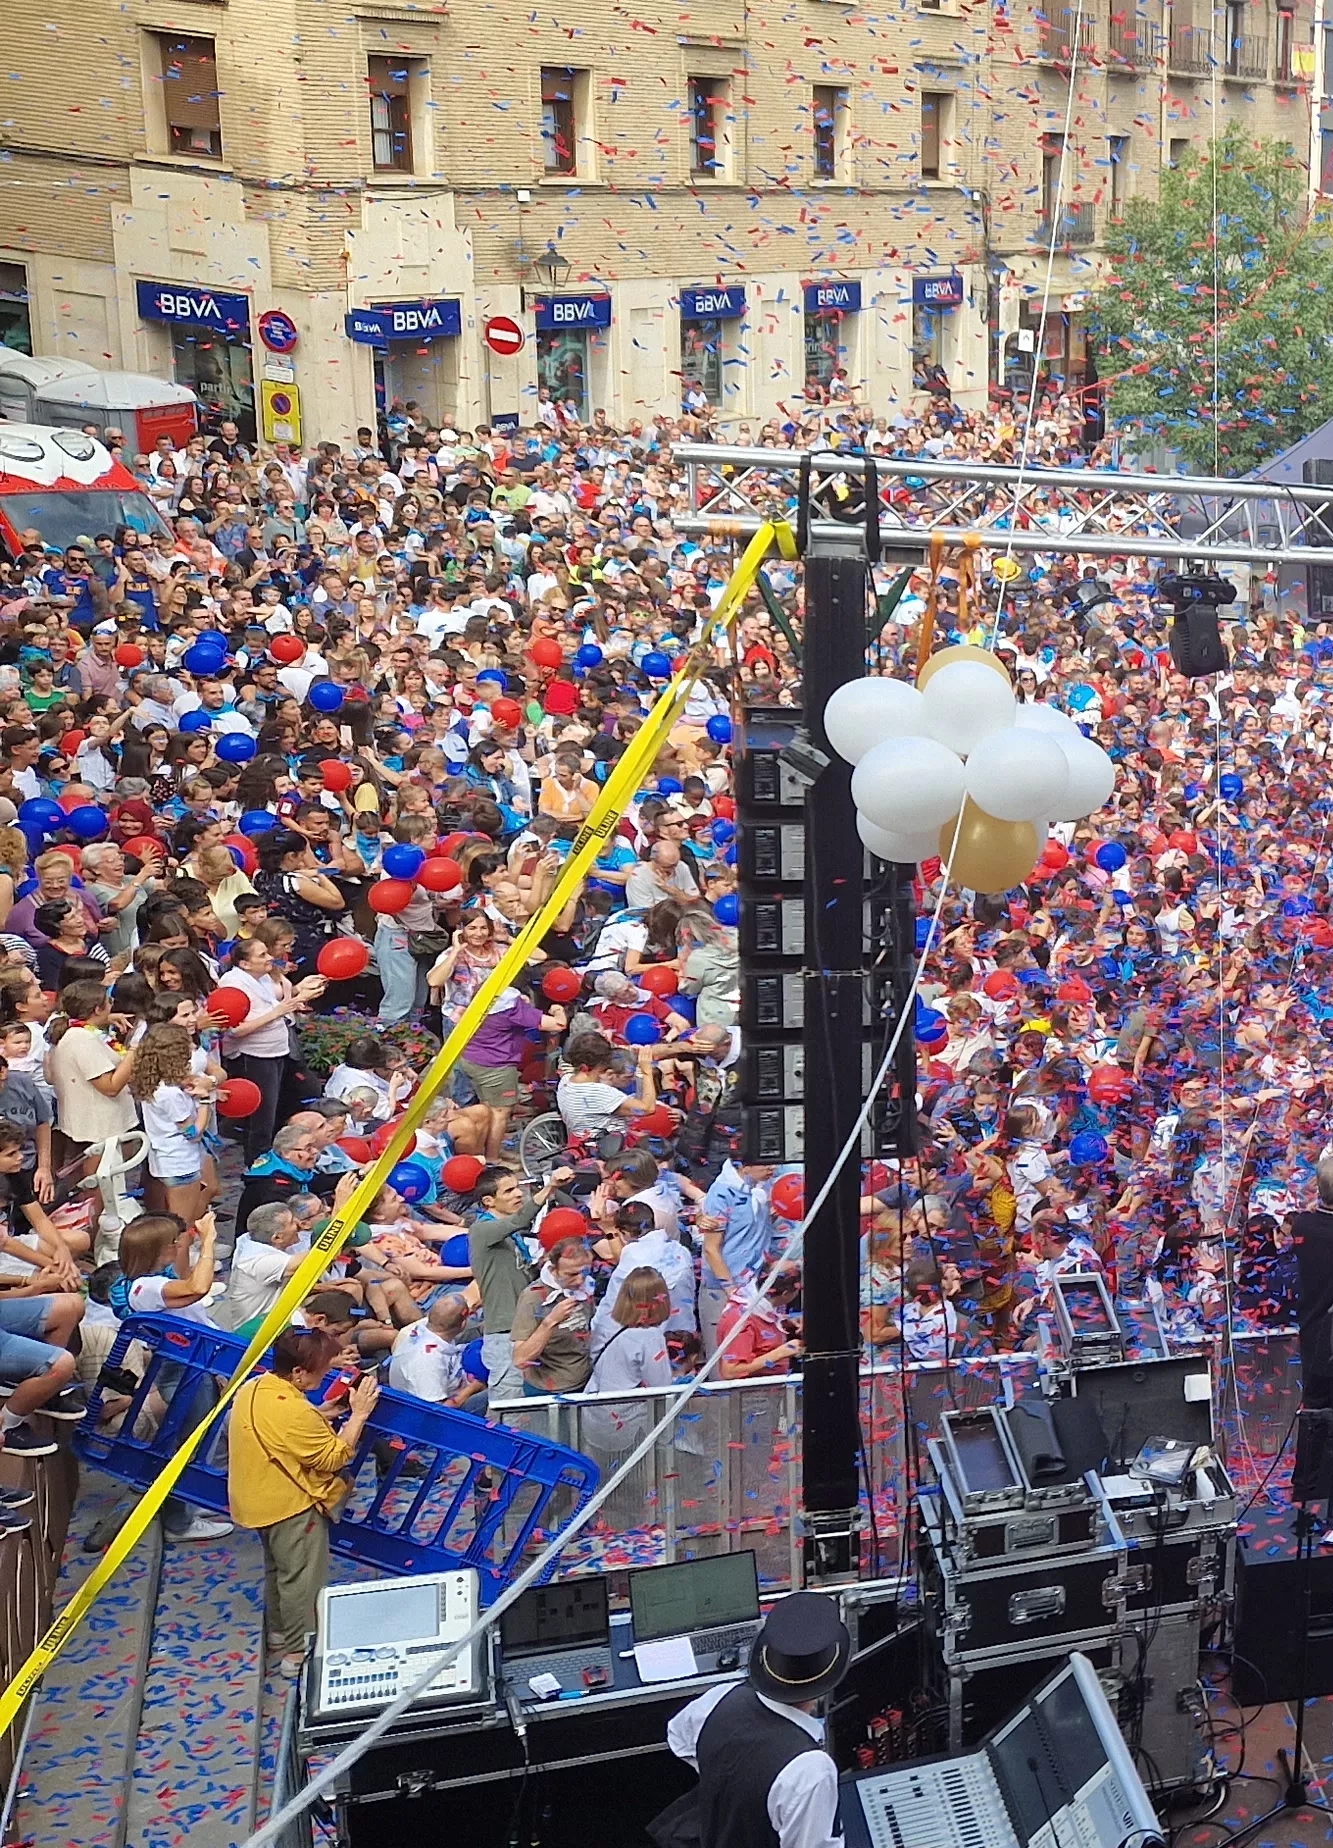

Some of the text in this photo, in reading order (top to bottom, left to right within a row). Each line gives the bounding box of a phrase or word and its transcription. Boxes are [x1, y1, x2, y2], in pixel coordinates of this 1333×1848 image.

[817, 286, 851, 306] BBVA
[924, 281, 953, 298] BBVA
[160, 293, 222, 319] BBVA
[553, 301, 596, 321] BBVA
[695, 292, 731, 313] BBVA
[393, 307, 443, 331] BBVA
[596, 810, 618, 838] ULINE
[318, 1220, 344, 1251] ULINE
